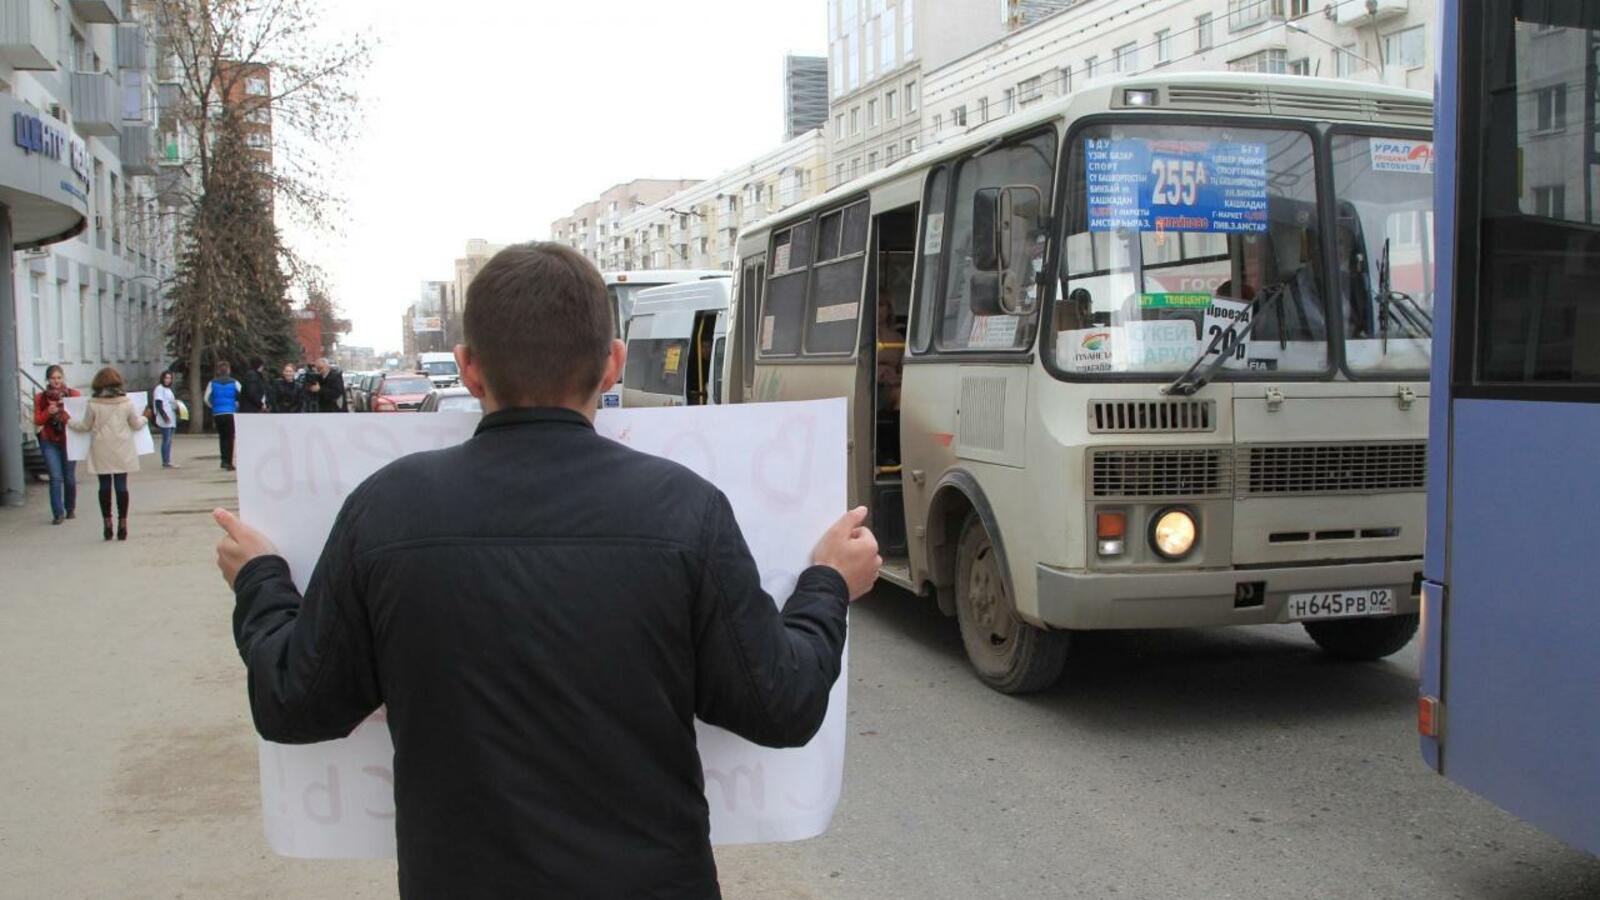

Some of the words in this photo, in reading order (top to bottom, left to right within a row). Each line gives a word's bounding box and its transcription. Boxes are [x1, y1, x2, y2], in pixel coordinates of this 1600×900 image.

[1375, 144, 1412, 153] УРАЛ
[1089, 162, 1118, 172] СПОРТ
[1206, 304, 1250, 323] Проезд
[1370, 591, 1387, 605] 02
